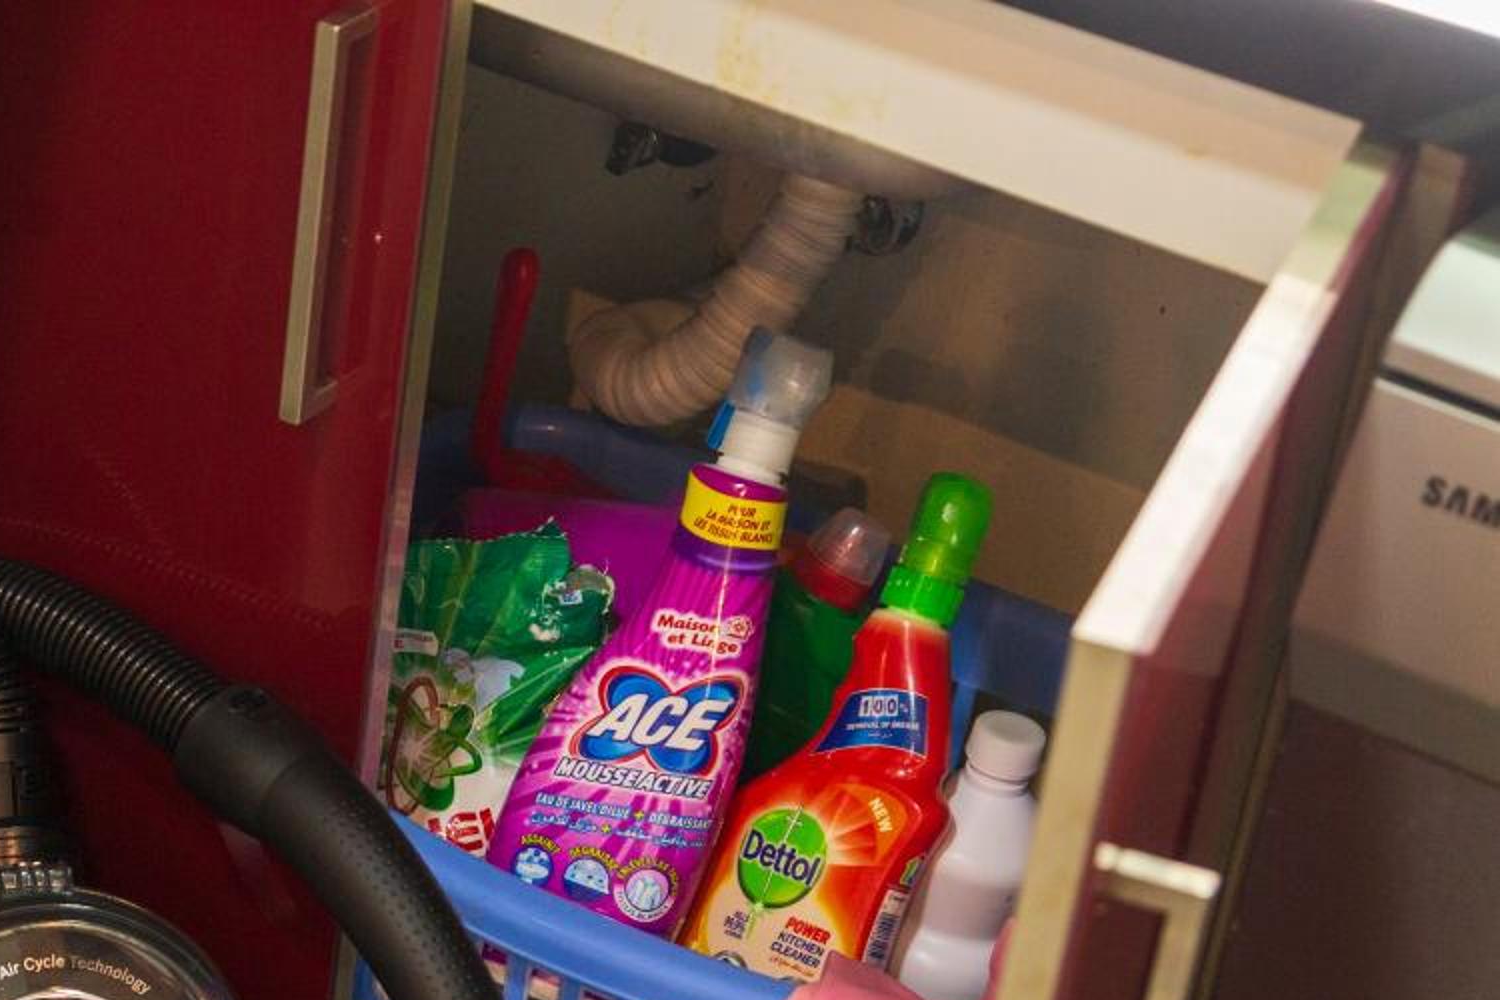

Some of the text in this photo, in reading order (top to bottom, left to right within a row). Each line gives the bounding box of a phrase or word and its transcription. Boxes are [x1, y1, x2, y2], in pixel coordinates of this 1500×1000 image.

[667, 634, 685, 645] et
[586, 693, 735, 751] ACE
[555, 757, 712, 798] MOUSSE ACTIVE
[868, 797, 893, 833] NEW
[743, 828, 821, 886] Dettol
[777, 931, 825, 956] KITCHEN
[785, 916, 831, 945] POWER
[770, 941, 821, 968] CLEANER
[23, 953, 66, 973] Cycle
[71, 955, 152, 995] Technology
